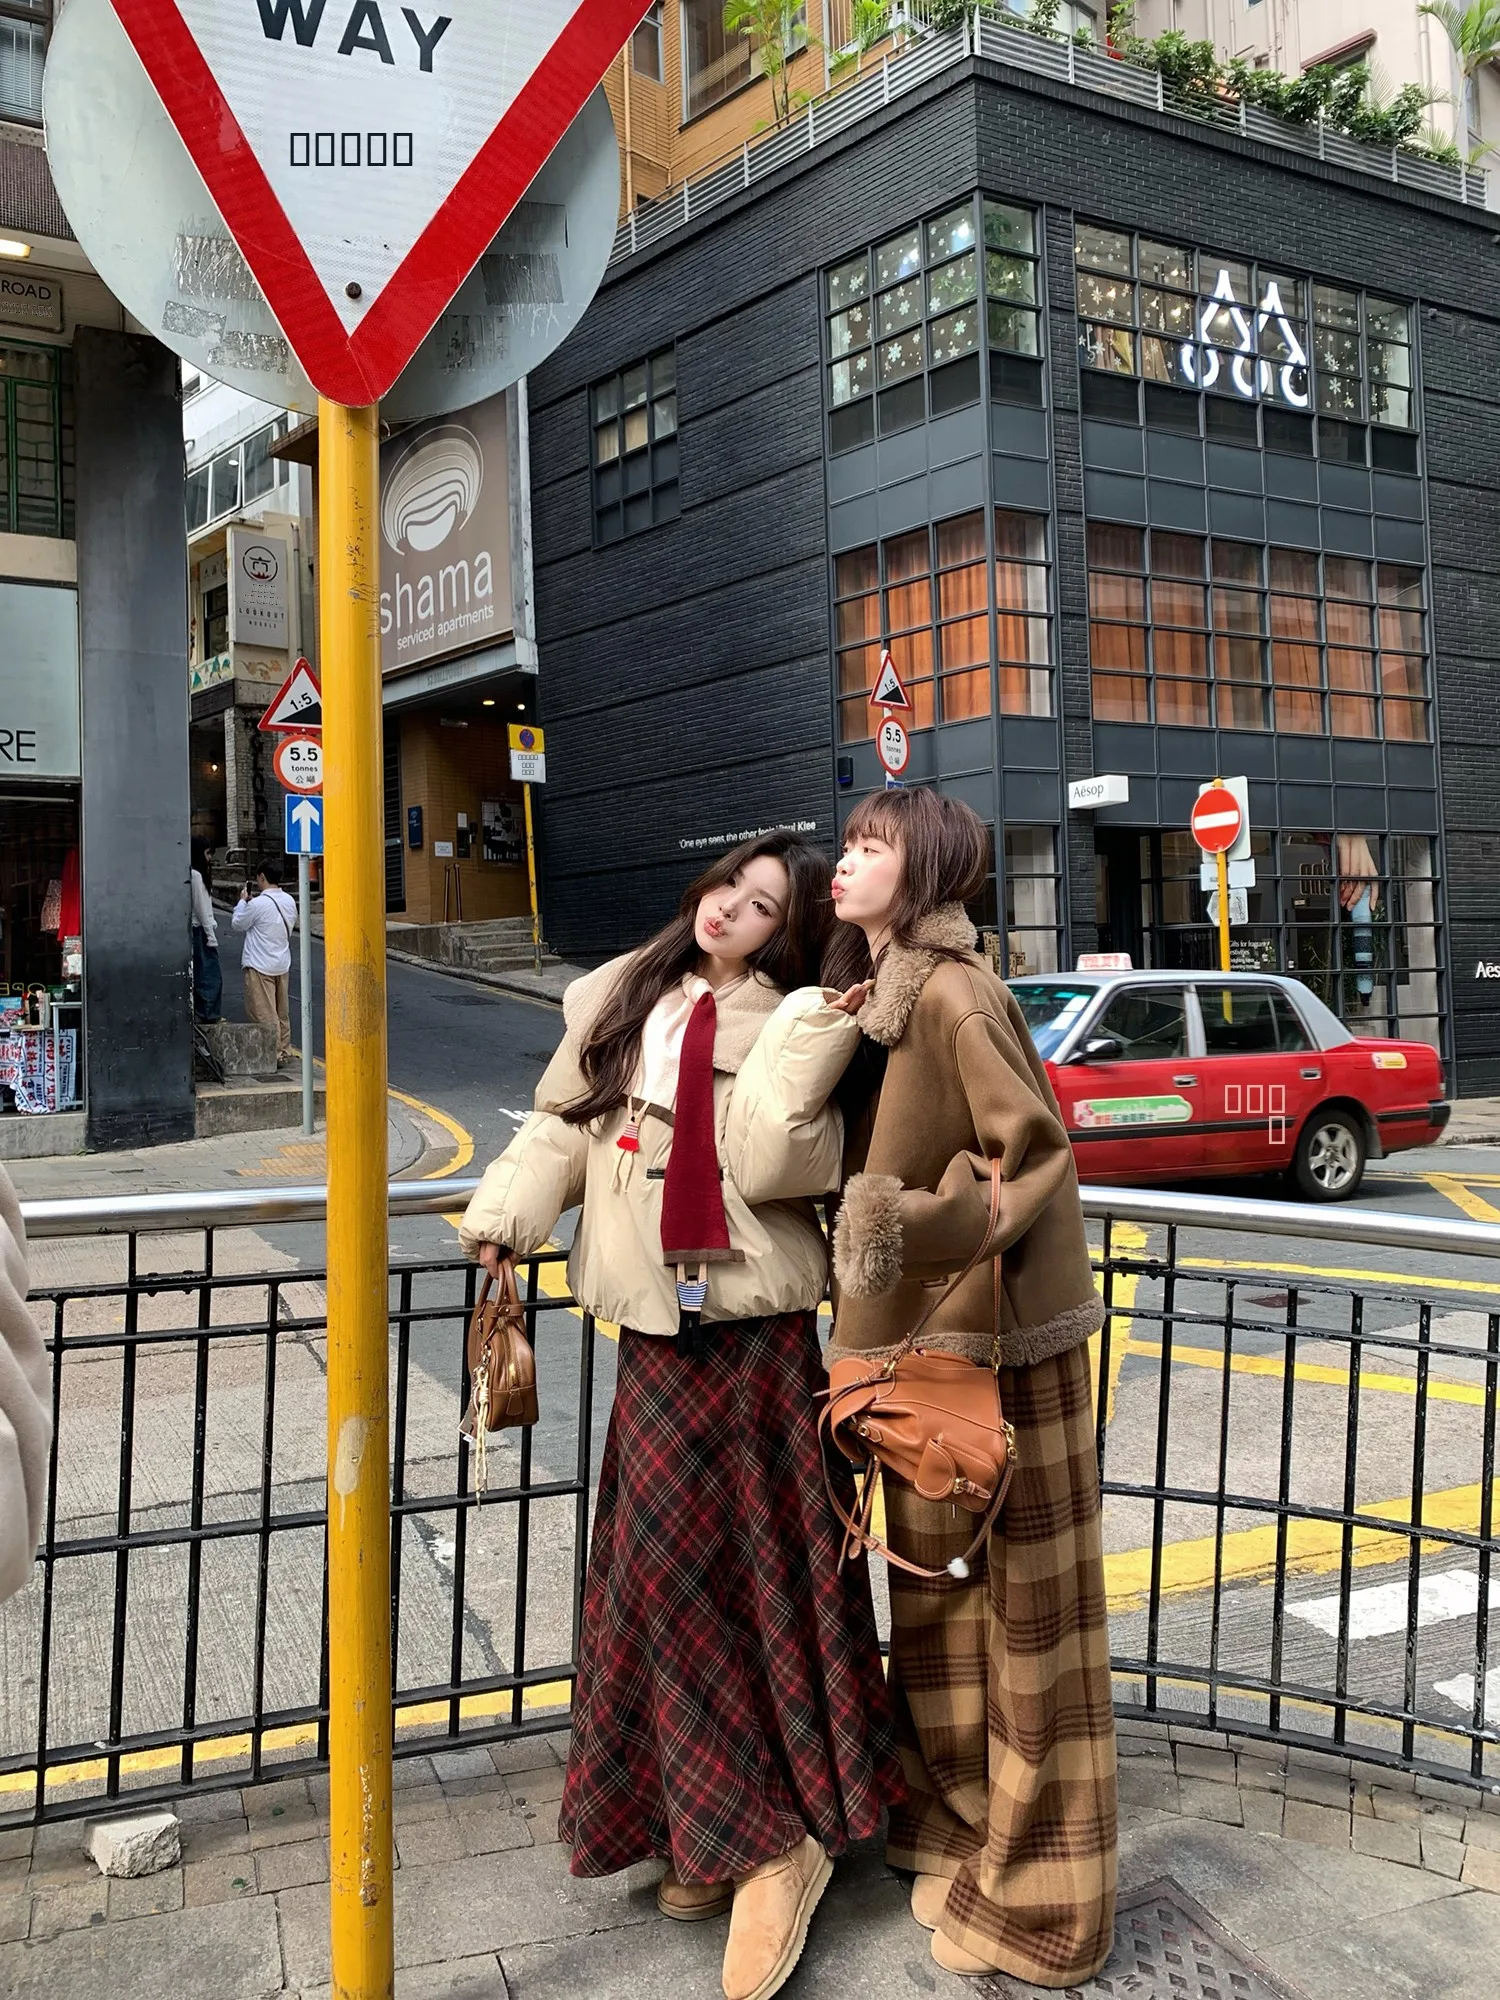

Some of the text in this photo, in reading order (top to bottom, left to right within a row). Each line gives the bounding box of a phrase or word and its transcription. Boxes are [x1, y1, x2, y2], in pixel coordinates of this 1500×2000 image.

[256, 0, 453, 73] WAY
[1, 280, 51, 300] ROAD
[380, 551, 493, 634] shama
[239, 608, 284, 619] LOOKOUT
[397, 604, 494, 650] serviced apartments
[884, 679, 896, 692] 1:5
[290, 692, 312, 711] 1:5
[886, 727, 901, 743] 5.5
[290, 747, 318, 761] 5.5
[695, 838, 708, 849] eye
[726, 832, 738, 842] the
[738, 829, 757, 841] other
[797, 821, 816, 831] Klee
